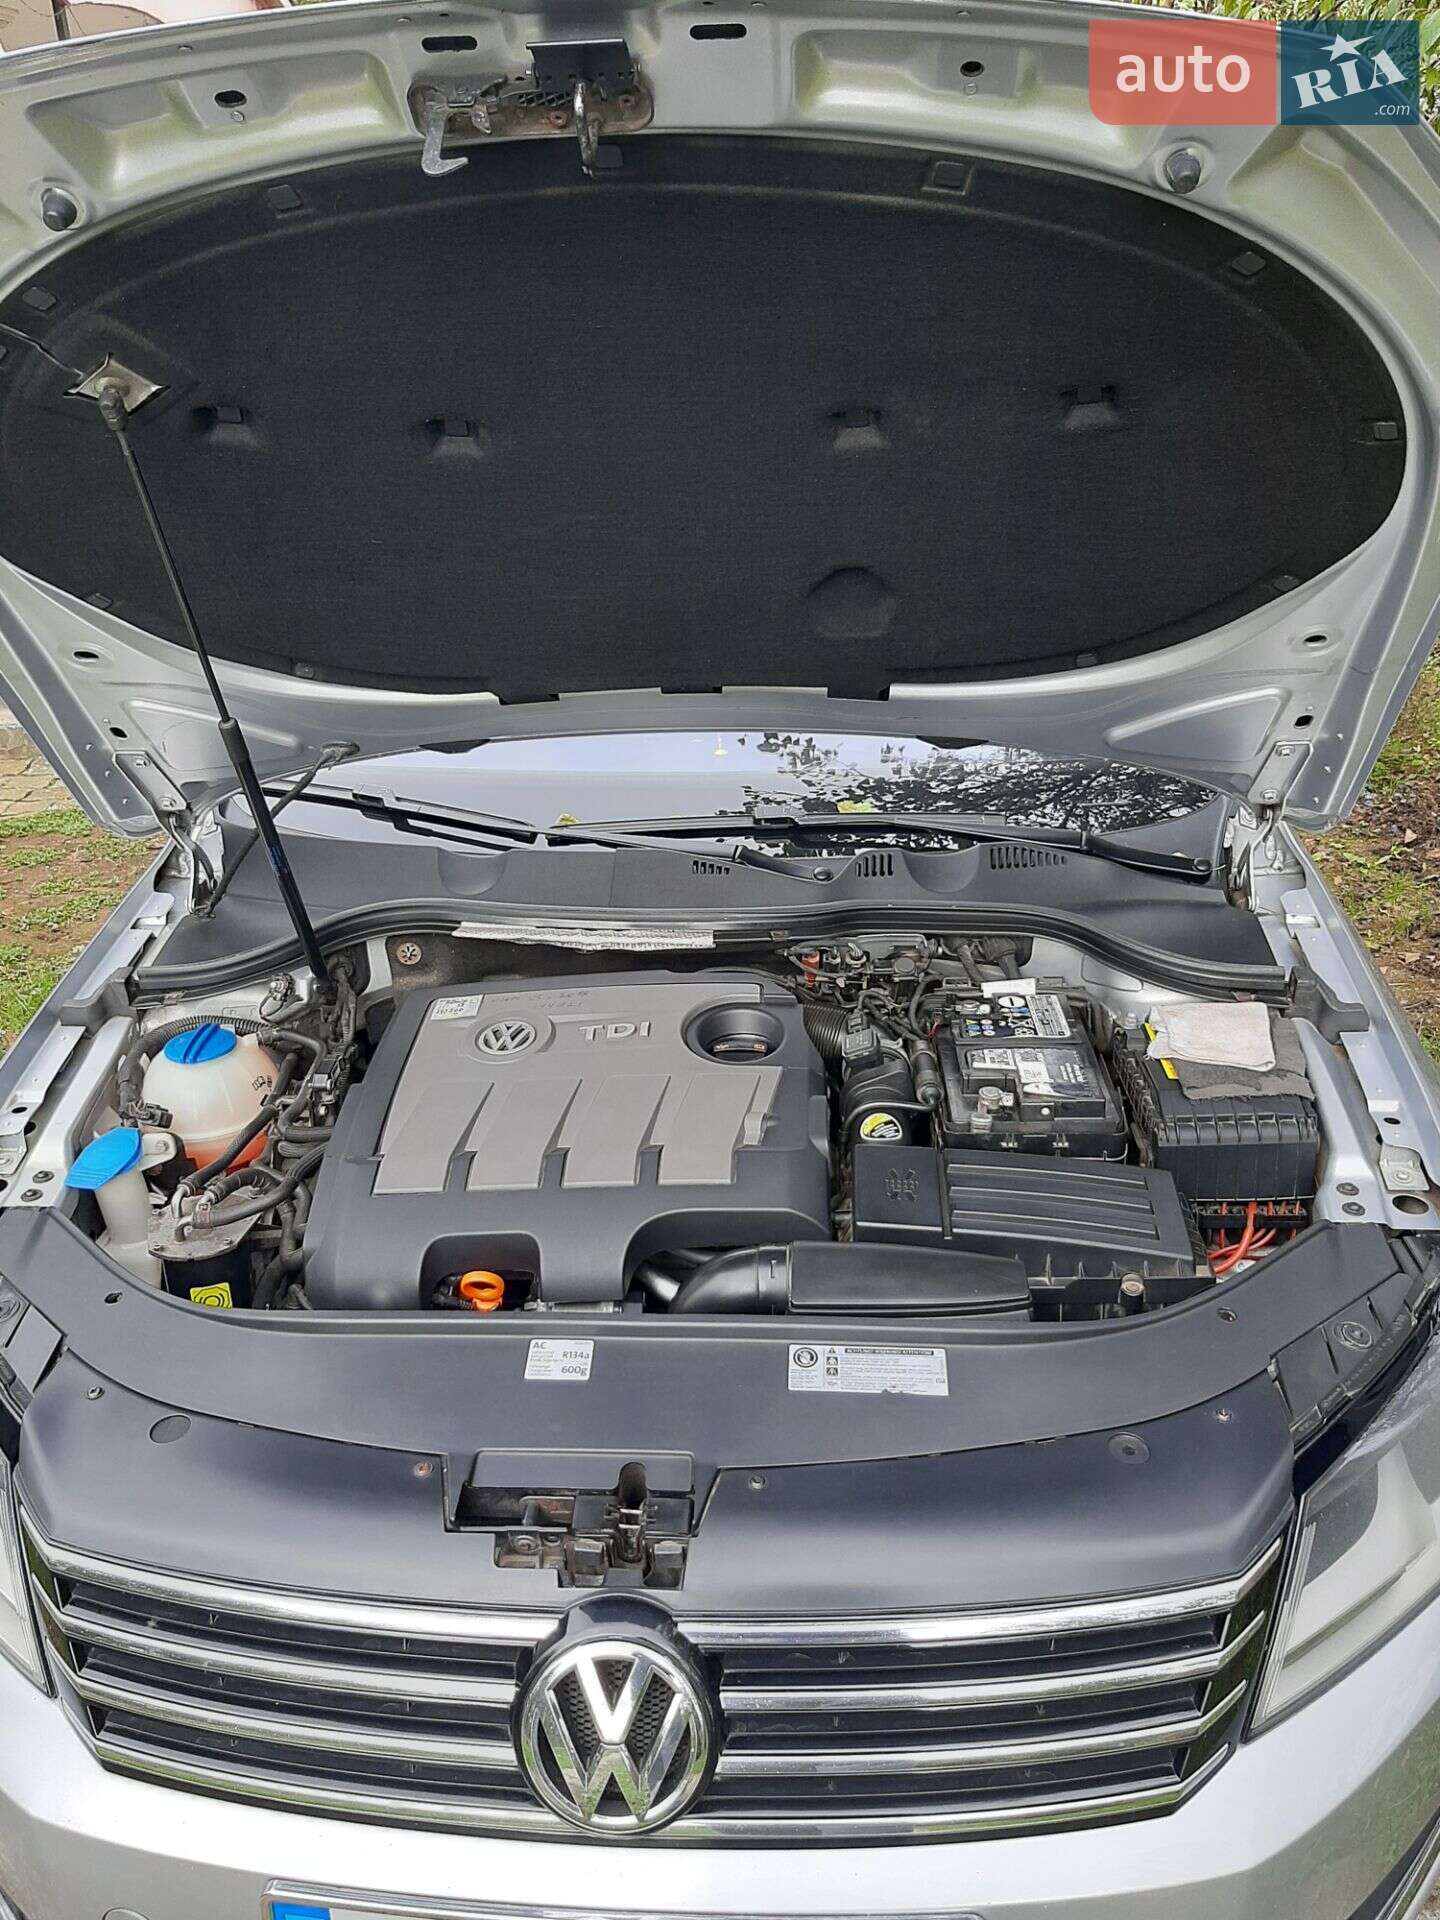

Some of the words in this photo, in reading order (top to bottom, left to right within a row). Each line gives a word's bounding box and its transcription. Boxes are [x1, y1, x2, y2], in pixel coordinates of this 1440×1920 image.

[579, 1020, 651, 1041] TDI
[532, 1341, 547, 1350] AC
[562, 1351, 590, 1360] R134a
[561, 1365, 588, 1377] 600g
[524, 1643, 706, 1831] VW
